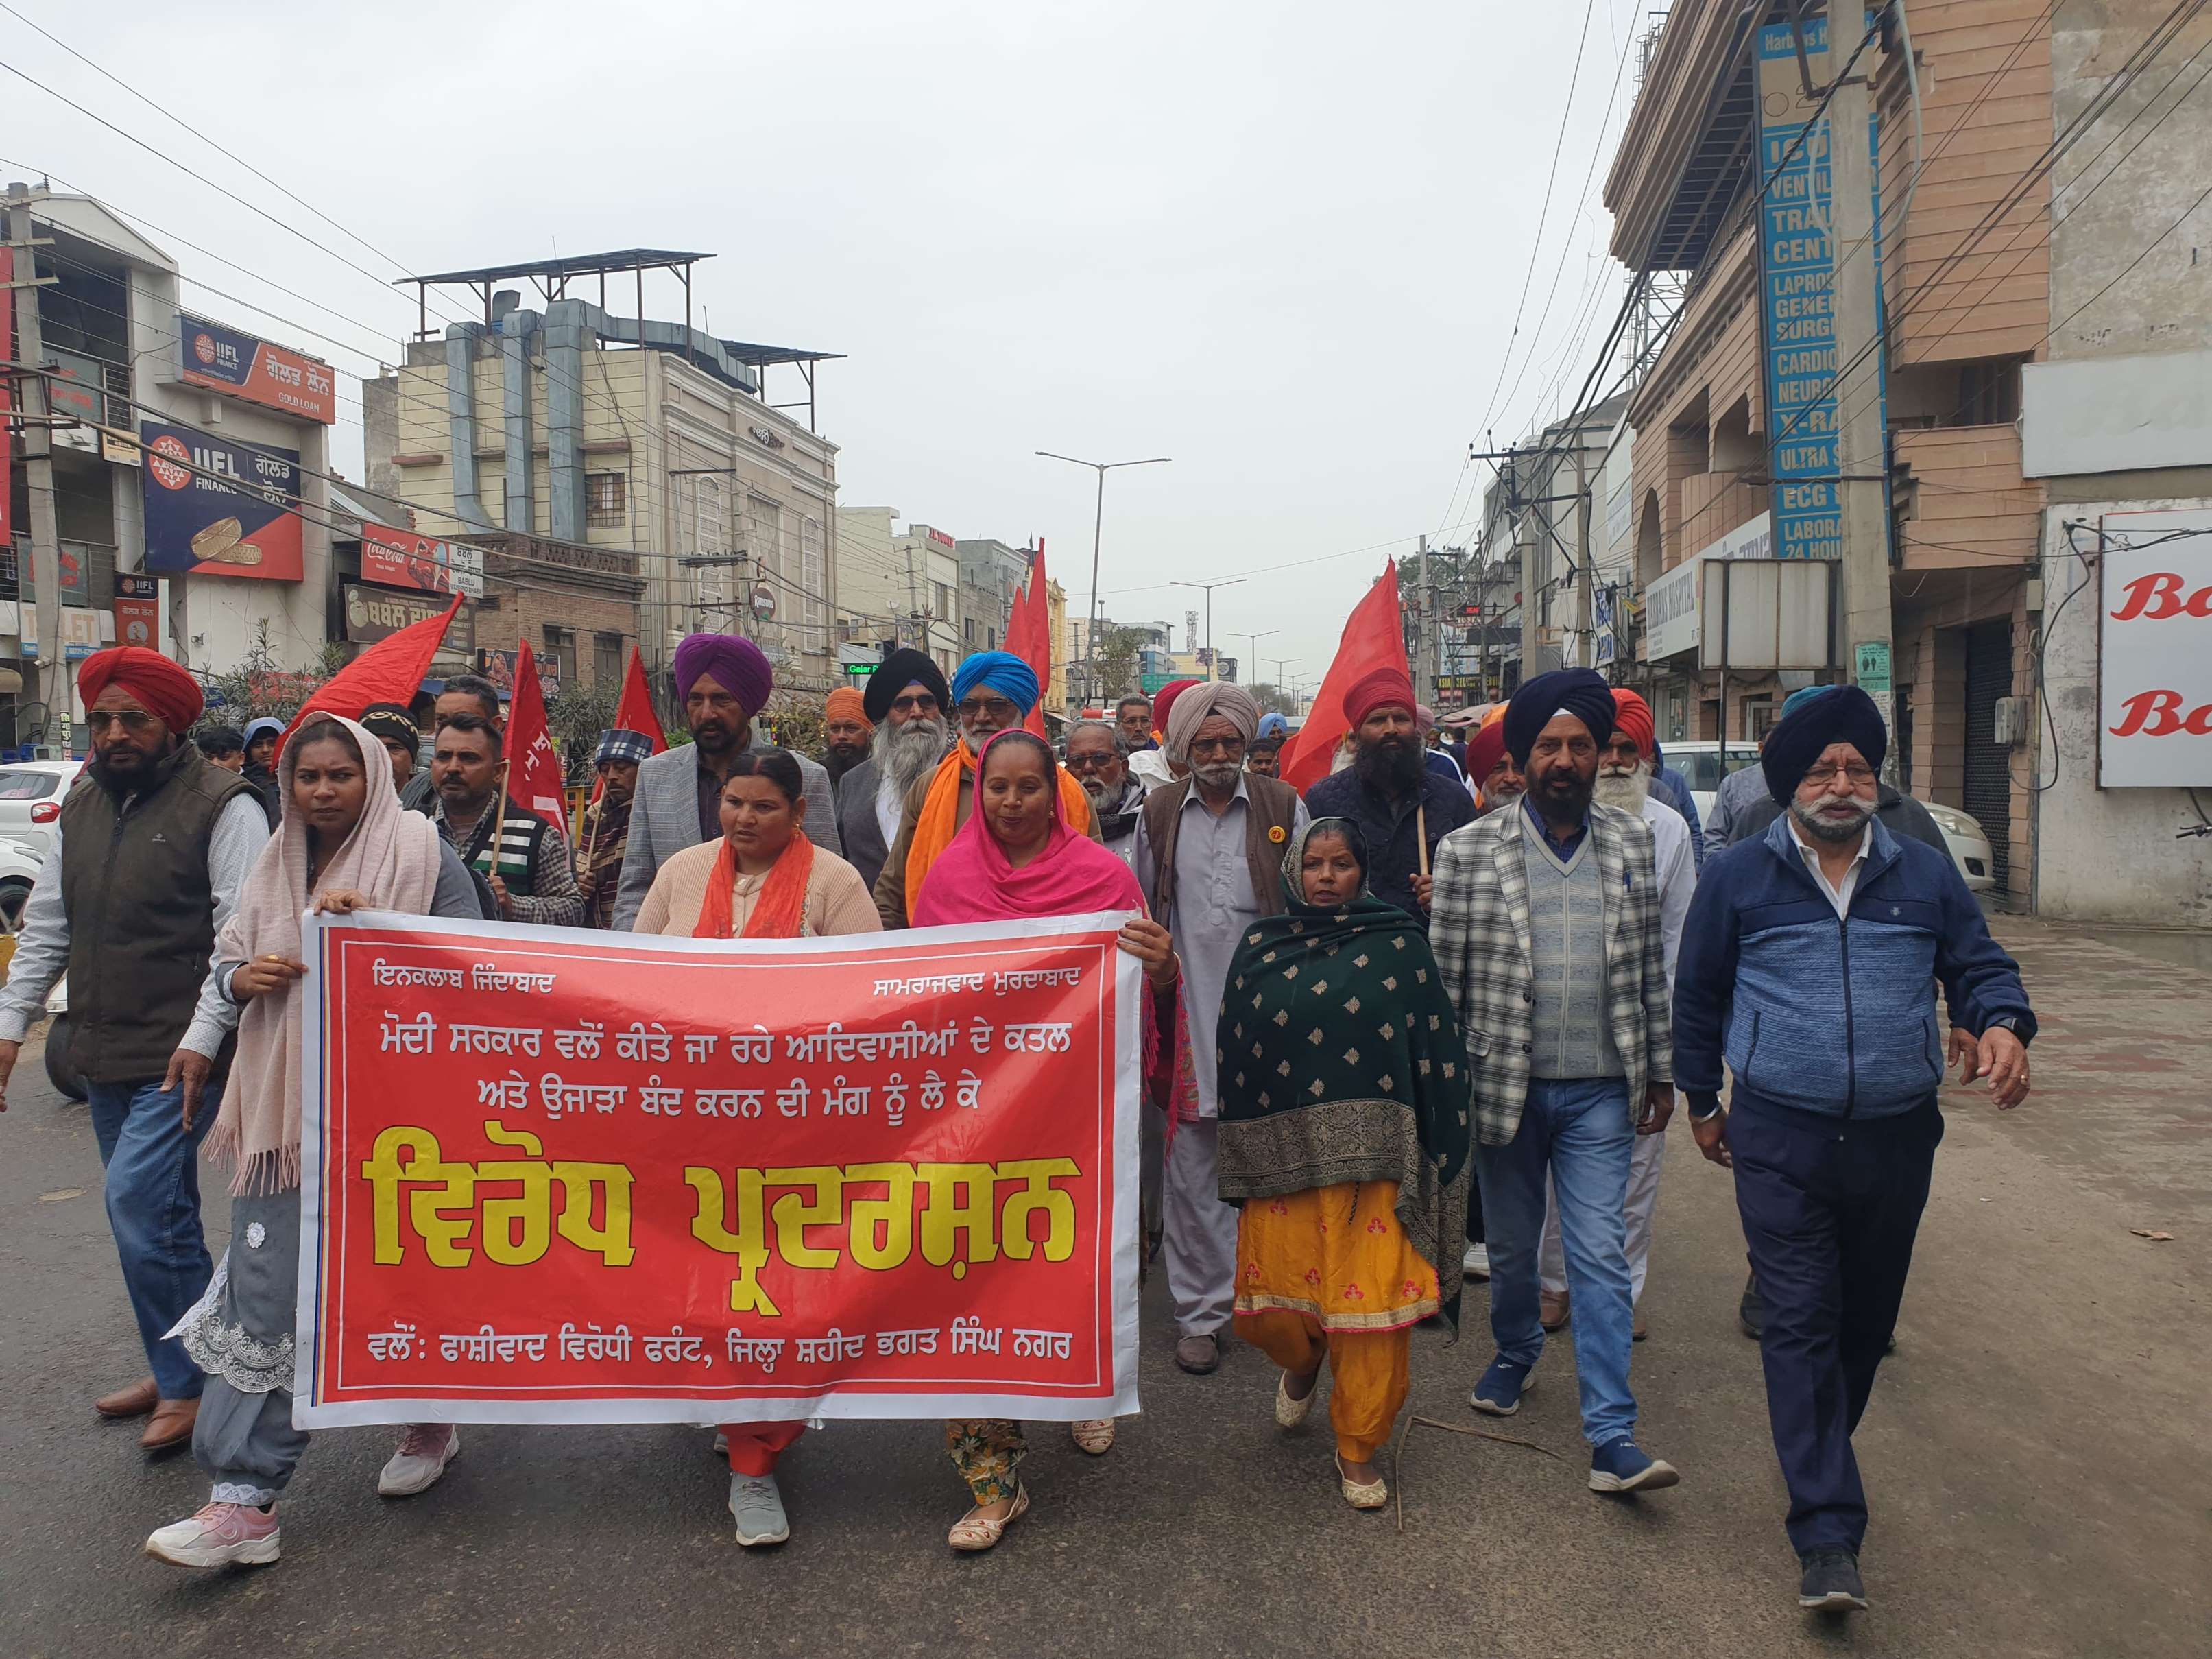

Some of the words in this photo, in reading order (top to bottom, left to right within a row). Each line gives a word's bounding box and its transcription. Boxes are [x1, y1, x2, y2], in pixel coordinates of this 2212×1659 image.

[216, 342, 239, 362] IIFL
[278, 392, 299, 407] GOLD
[300, 396, 320, 414] LOAN
[194, 447, 240, 478] IIFL
[1781, 446, 1829, 471] ULTRA
[1783, 484, 1827, 510] ECG
[136, 580, 154, 590] IIFL
[458, 576, 475, 586] BABLU
[372, 957, 464, 989] ਇਨਕਲਾਬ
[471, 963, 556, 993] ਜਿੰਦਾਬਾਦ
[873, 972, 986, 996] ਸਾਮਰਾਜਵਾਦ
[993, 966, 1081, 996] ਮੁਰਦਾਬਾਦ
[380, 1009, 438, 1055] ਮੋਦੀ
[448, 1023, 544, 1058] ਸਰਕਾਰ
[553, 1018, 604, 1060] ਵਲੋਂ
[615, 1022, 673, 1063] ਕੀਤੇ
[684, 1034, 719, 1064] ਜਾ
[730, 1024, 775, 1064] ਰਹੇ
[786, 1020, 959, 1064] ਆਦਿਵਾਸੀਆਂ
[969, 1016, 994, 1055] ਦੇ
[1004, 1022, 1073, 1054] ਕਤਲ
[477, 1069, 530, 1110] ਅਤੇ
[540, 1072, 628, 1120] ਉਜਾੜਾ
[638, 1075, 684, 1117] ਬੰਦ
[695, 1089, 765, 1119] ਕਰਨ
[776, 1077, 811, 1118] ਦੀ
[821, 1075, 872, 1117] ਮੰਗ
[882, 1072, 909, 1127] ਨੂੰ
[920, 1069, 947, 1111] ਲੈ
[957, 1068, 983, 1110] ਕੇ
[361, 1120, 636, 1269] ਵਿਰੋਧ
[684, 1156, 1083, 1317] ਪ੍ਰਦਰਸ਼ਨ
[439, 1324, 549, 1363] ਫਾਸ਼ੀਵਾਦ
[558, 1321, 634, 1363] ਵਿਰੋਧੀ
[642, 1324, 713, 1370] ਫਰੰਟ,
[725, 1327, 786, 1374] ਜਿਲ੍ਹਾ
[795, 1327, 867, 1363] ਸ਼ਹੀਦ
[876, 1328, 941, 1356] ਭਗਤ
[950, 1315, 1004, 1356] ਸਿੰਘ
[1012, 1328, 1074, 1360] ਨਗਰ
